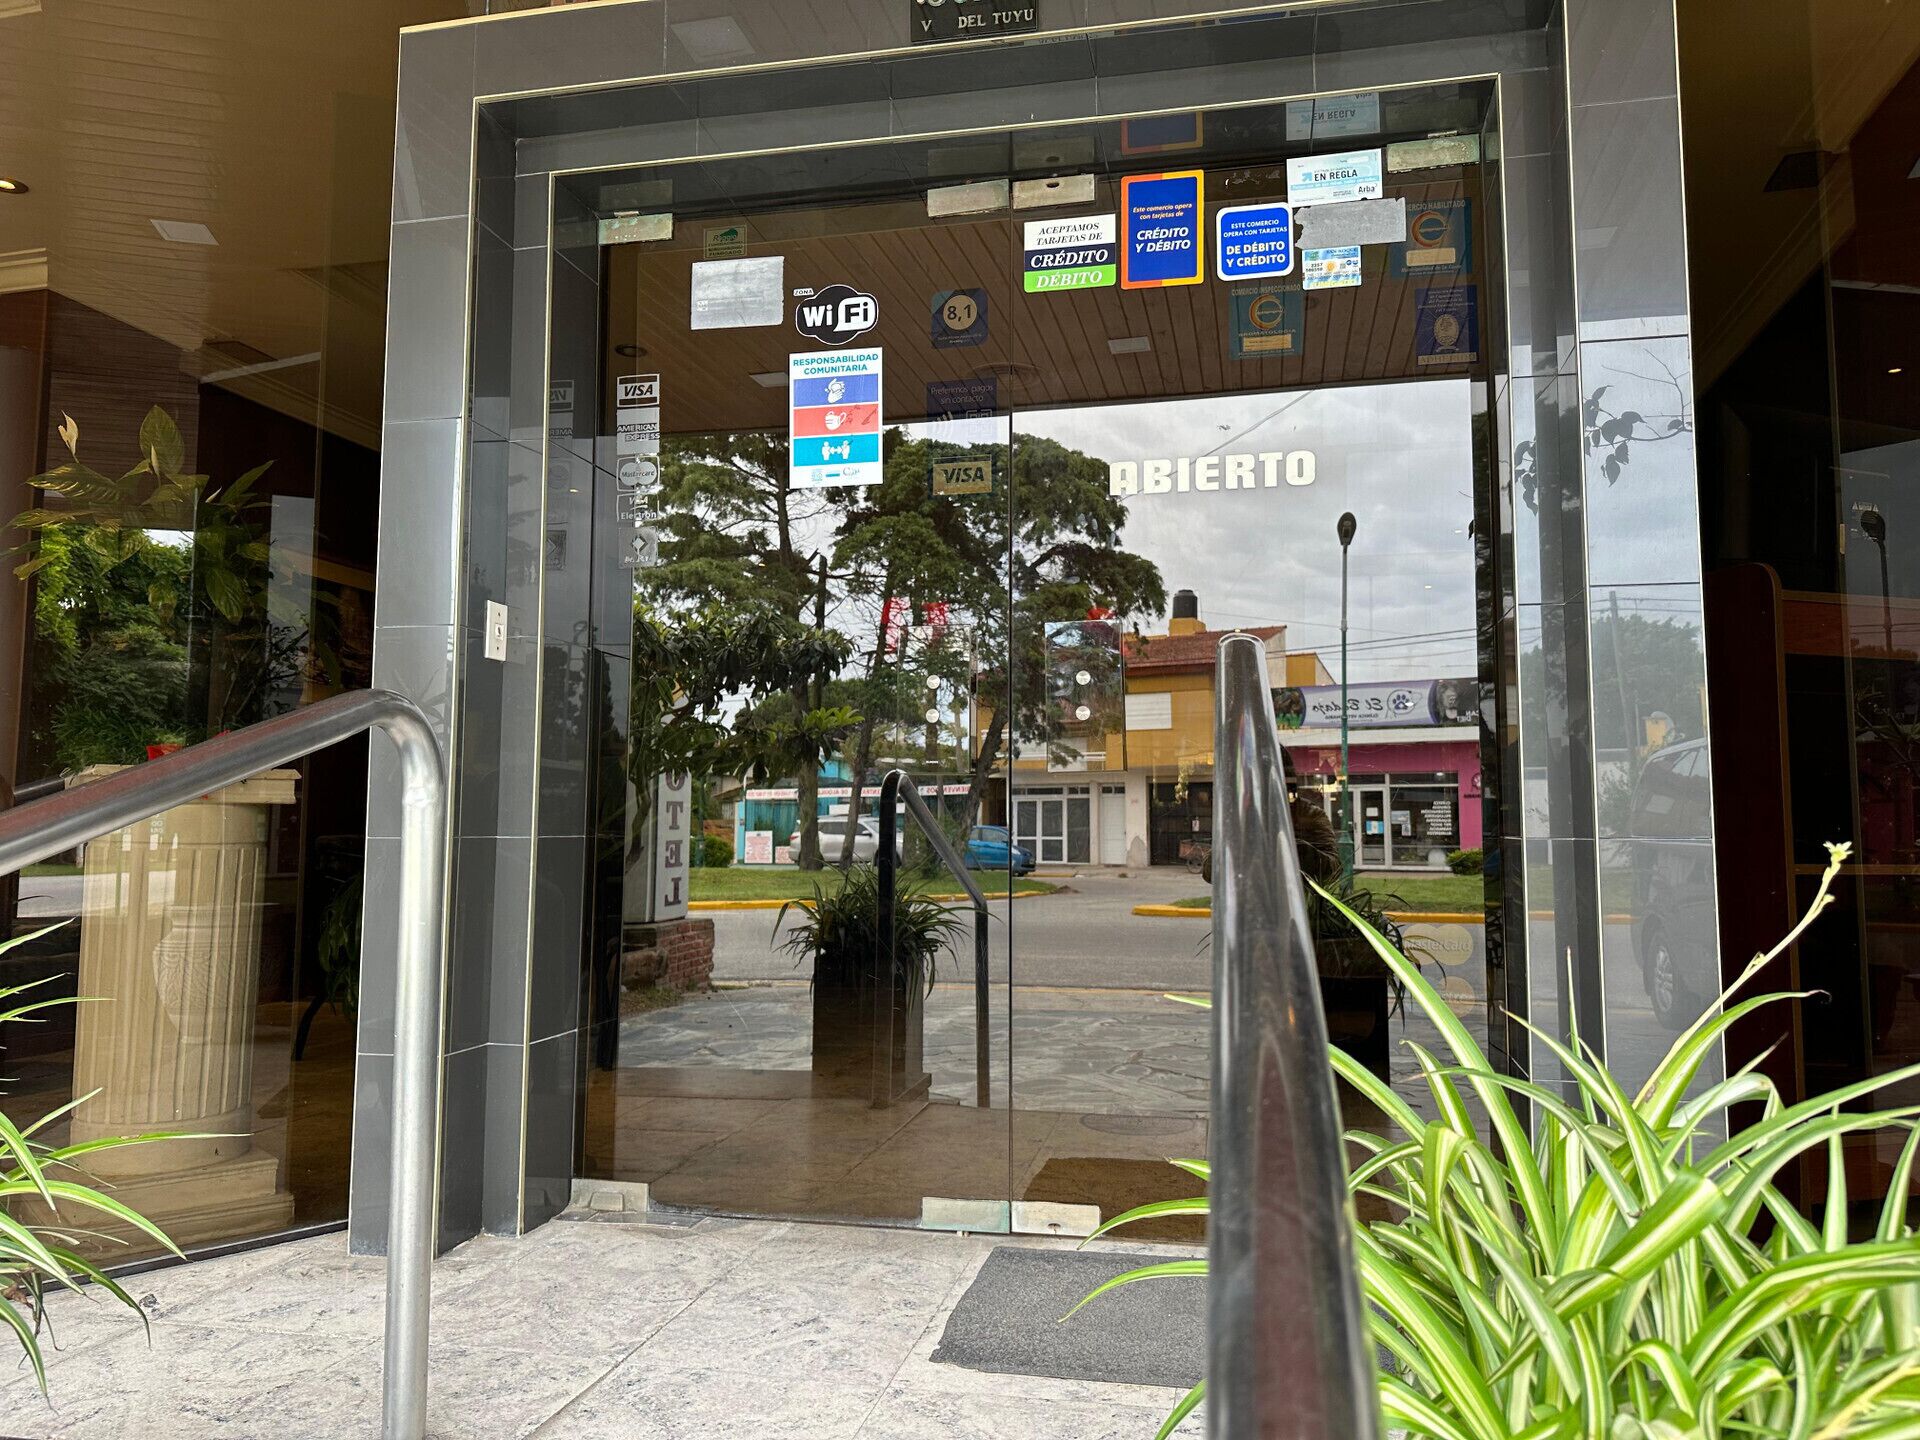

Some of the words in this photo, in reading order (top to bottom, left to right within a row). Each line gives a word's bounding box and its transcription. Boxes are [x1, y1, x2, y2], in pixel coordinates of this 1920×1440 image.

[958, 14, 986, 29] DEL
[992, 8, 1034, 25] TUYU
[1314, 173, 1326, 182] EN
[1329, 169, 1358, 180] REGLA
[1358, 185, 1376, 194] Arba
[1146, 204, 1174, 212] comercio
[1174, 203, 1193, 211] opera
[1428, 199, 1466, 210] HABILITADO
[1151, 212, 1175, 220] tarjetas
[1039, 222, 1099, 235] ACEPTAMOS
[1246, 219, 1279, 228] COMERCIO
[1259, 226, 1287, 234] TARJETAS
[1037, 234, 1086, 245] TARJETAS
[1088, 232, 1103, 241] DE
[1136, 227, 1189, 241] CRÉDITO
[1135, 243, 1145, 253] Y
[1146, 239, 1191, 253] DÉBITO
[1226, 245, 1241, 256] DE
[1243, 241, 1285, 254] DÉBITO
[1030, 249, 1109, 268] CRÉDITO
[1226, 258, 1234, 268] Y
[1236, 254, 1286, 267] CRÉDITO
[1036, 270, 1103, 289] DÉBITO
[1231, 287, 1258, 296] COMERCIO
[1260, 284, 1300, 294] INSPECCIONADO
[947, 304, 971, 322] 8,1
[793, 353, 879, 366] RESPONSABILIDAD
[803, 363, 868, 375] COMUNITARIA
[624, 384, 653, 397] VISA
[930, 386, 968, 396] Preferimos
[971, 384, 993, 394] pagos
[940, 396, 953, 405] sin
[953, 395, 984, 404] contacto
[617, 423, 658, 433] AMERICAN
[626, 432, 660, 441] EXPRESS
[941, 466, 985, 484] VISA
[1109, 450, 1316, 496] ABIERTO
[620, 511, 657, 520] Electron
